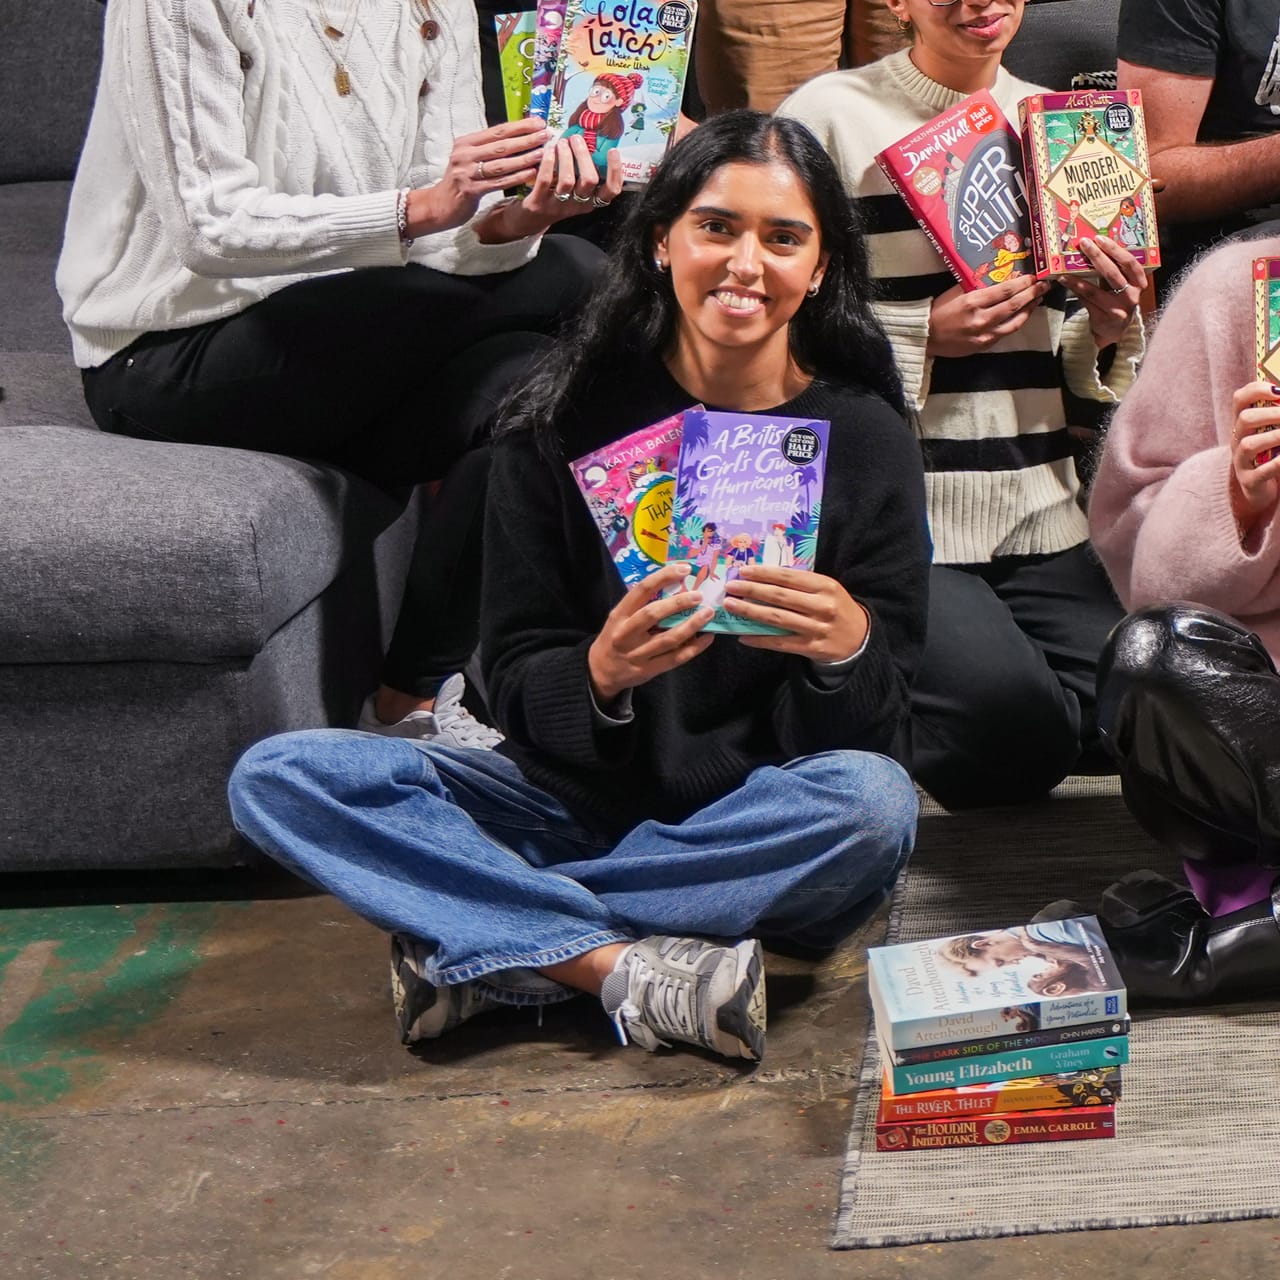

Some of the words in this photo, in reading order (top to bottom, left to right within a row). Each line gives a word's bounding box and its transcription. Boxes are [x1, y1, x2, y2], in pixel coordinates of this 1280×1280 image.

[588, 27, 662, 61] Larch
[606, 59, 632, 70] Winter
[633, 61, 650, 71] Wish
[612, 51, 632, 60] Make
[969, 107, 988, 121] Half
[974, 113, 994, 132] price
[903, 139, 944, 176] David
[1063, 155, 1120, 184] MURDER!
[958, 144, 1016, 236] SUPER
[1067, 186, 1076, 197] BY
[1077, 172, 1136, 205] NARWHAL!
[713, 430, 728, 450] A
[729, 423, 795, 450] Britis
[603, 446, 645, 470] KATYA
[646, 426, 684, 451] BALEN
[787, 450, 813, 458] PRICE
[696, 449, 750, 481] Girl's
[712, 471, 803, 497] Hurricanes
[715, 495, 801, 520] Heartbreak
[938, 1013, 974, 1028] David
[914, 1023, 998, 1042] Attenborough
[1060, 1030, 1080, 1041] JOHN
[1082, 1027, 1105, 1037] HARRIS
[935, 1048, 960, 1058] DARK
[963, 1044, 984, 1055] SIDE
[987, 1041, 1001, 1051] OF
[1004, 1038, 1023, 1049] THE
[1050, 1048, 1090, 1060] Graham
[905, 1070, 955, 1086] Young
[960, 1057, 1033, 1079] Elizabeth
[894, 1104, 913, 1115] THE
[917, 1099, 954, 1113] RIVER
[928, 1122, 976, 1136] HOUDINI
[1014, 1125, 1047, 1135] EMMA
[1048, 1122, 1097, 1133] CARROLL
[912, 1133, 982, 1147] INHERITANCE
